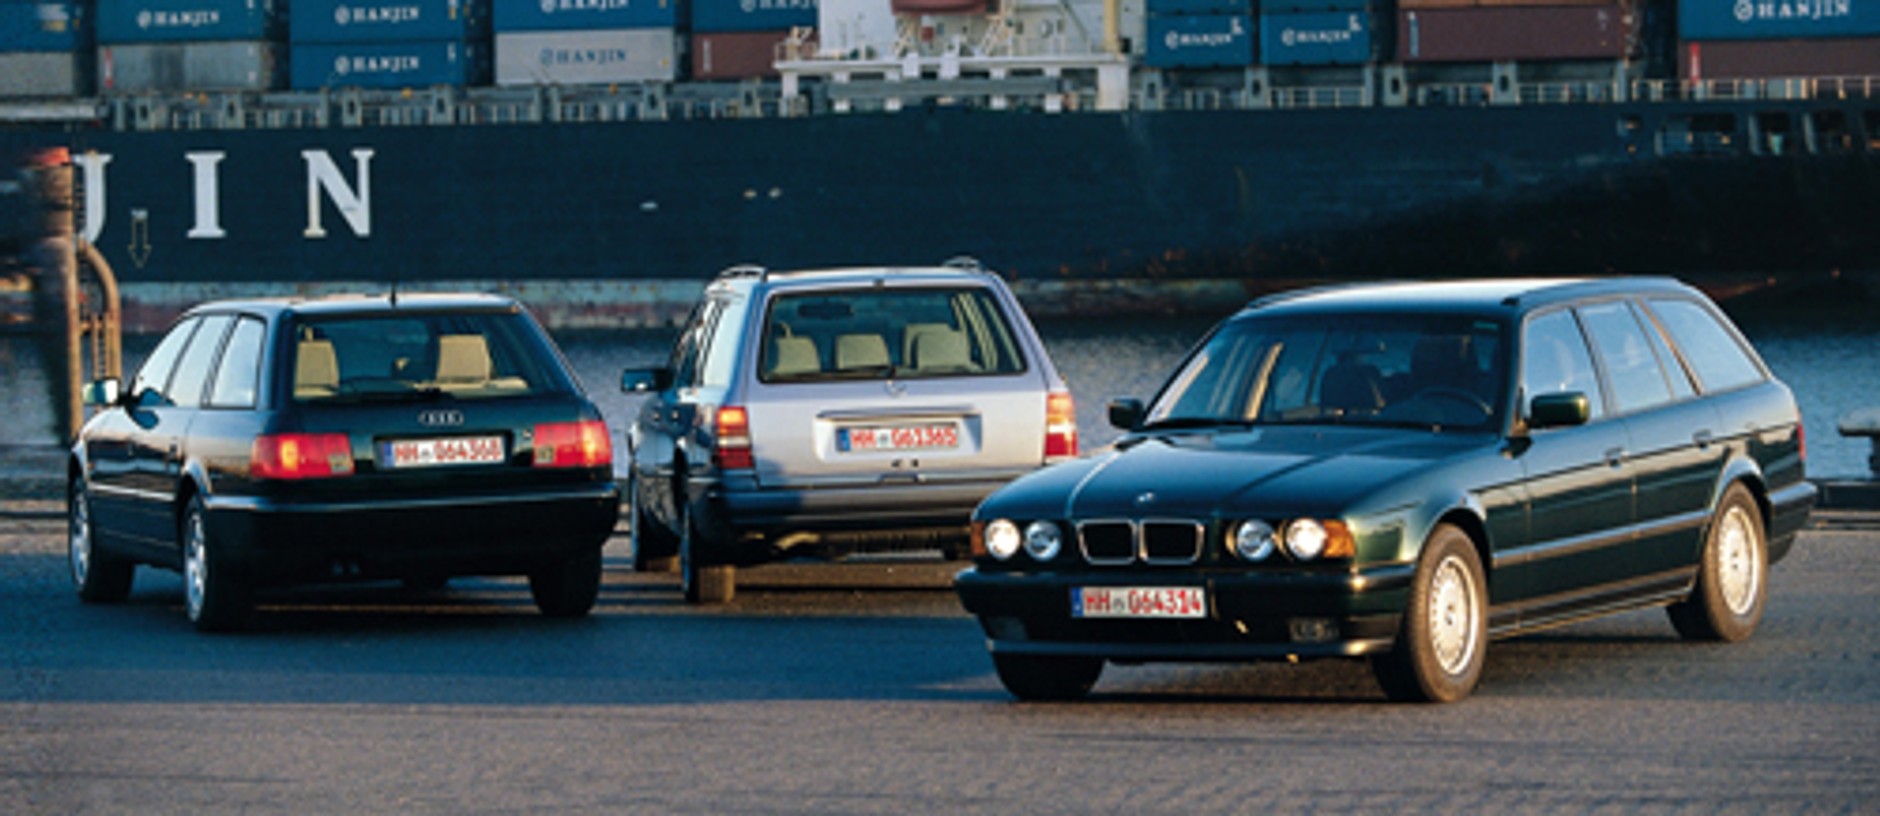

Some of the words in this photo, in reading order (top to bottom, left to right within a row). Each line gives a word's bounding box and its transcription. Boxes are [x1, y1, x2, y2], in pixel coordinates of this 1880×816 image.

[154, 10, 220, 26] HANJIN
[353, 6, 419, 23] HANJIN
[1757, 0, 1849, 20] HANJIN
[353, 56, 419, 73] HANJIN
[556, 47, 626, 65] HANJIN
